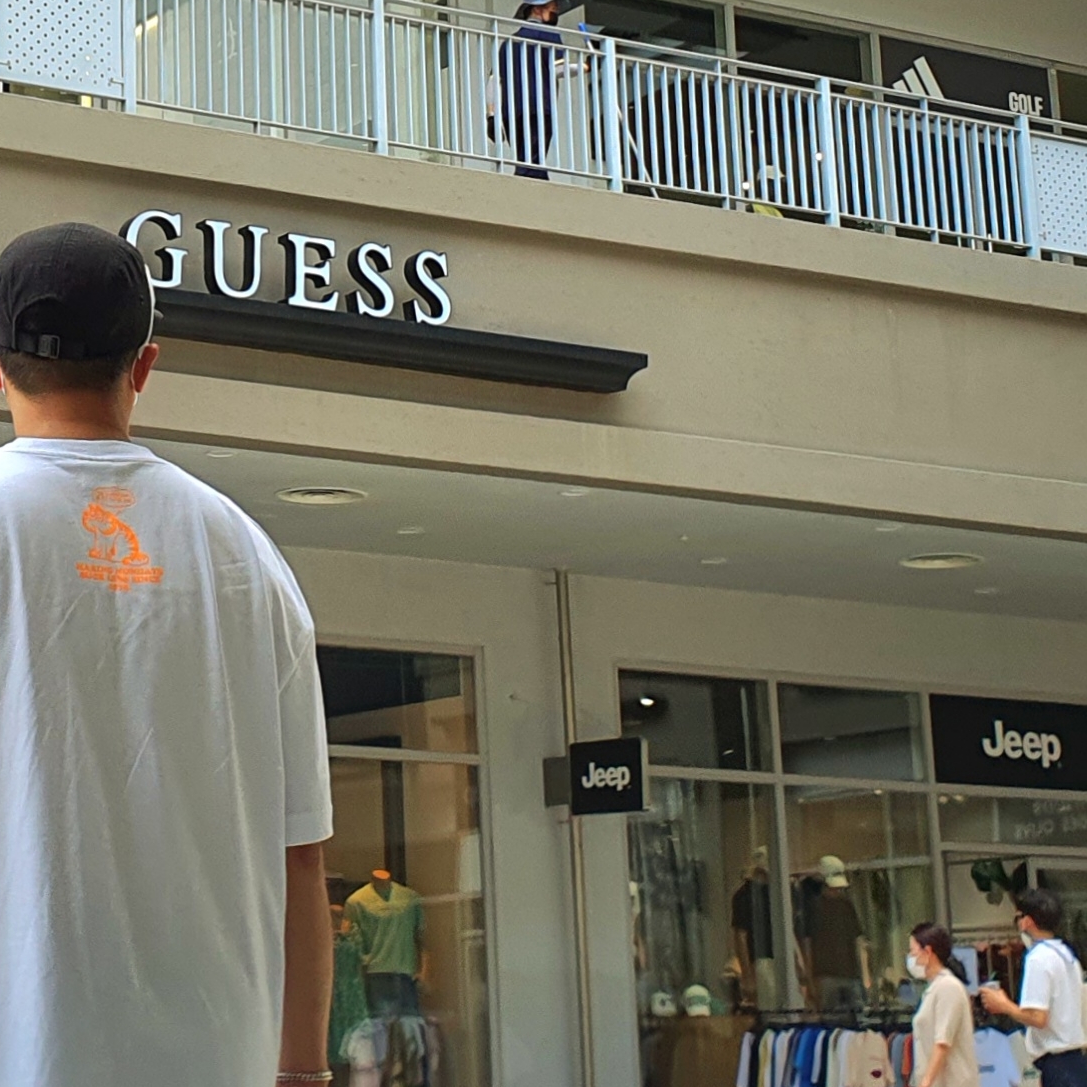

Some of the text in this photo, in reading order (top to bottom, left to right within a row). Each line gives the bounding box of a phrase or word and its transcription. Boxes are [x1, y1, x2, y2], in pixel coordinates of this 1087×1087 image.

[1008, 91, 1044, 116] GOLF
[119, 208, 453, 326] GUESS
[981, 719, 1062, 769] Jeep
[581, 762, 631, 792] Jeep
